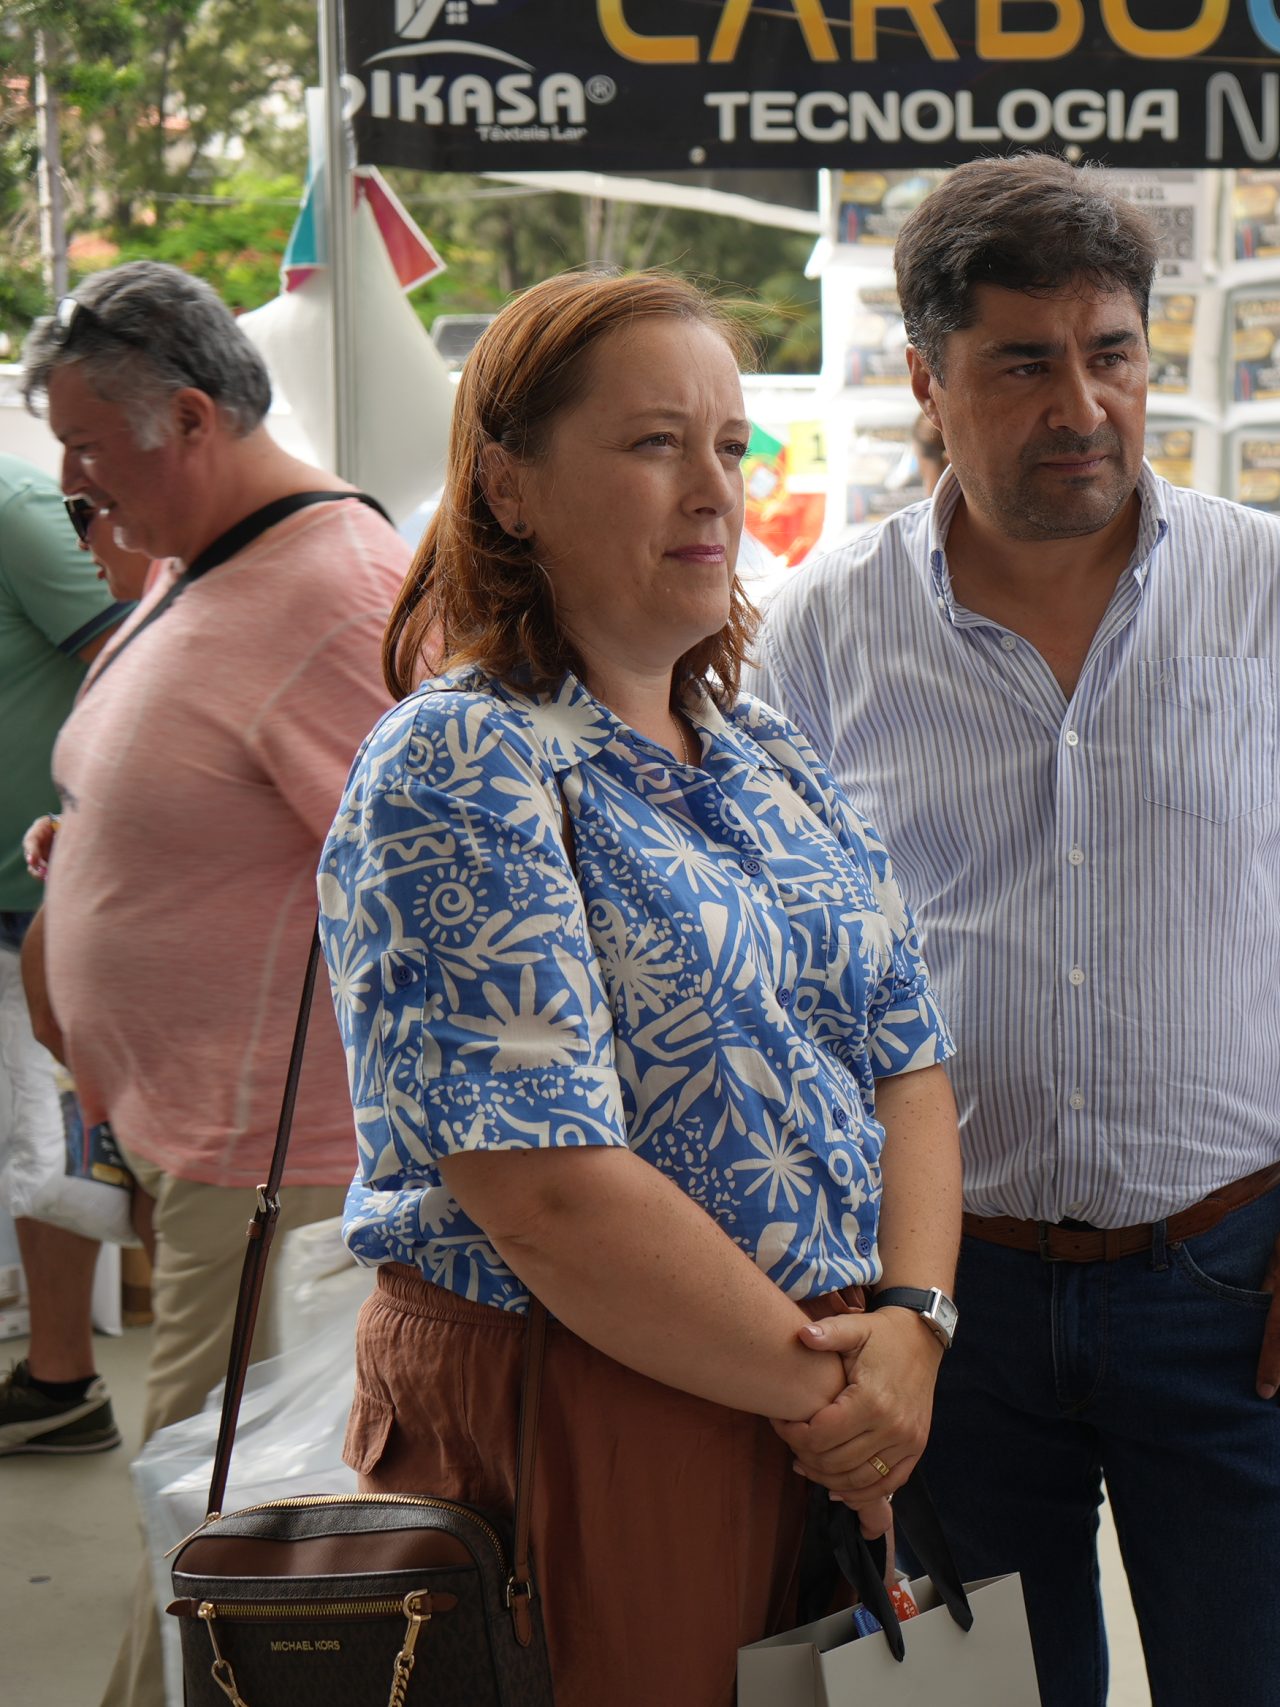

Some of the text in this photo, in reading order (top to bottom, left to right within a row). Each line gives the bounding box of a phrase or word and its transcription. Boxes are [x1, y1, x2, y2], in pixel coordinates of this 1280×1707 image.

[705, 89, 1178, 143] TECNOLOGIA
[271, 1639, 340, 1652] MICHAEL KORS
